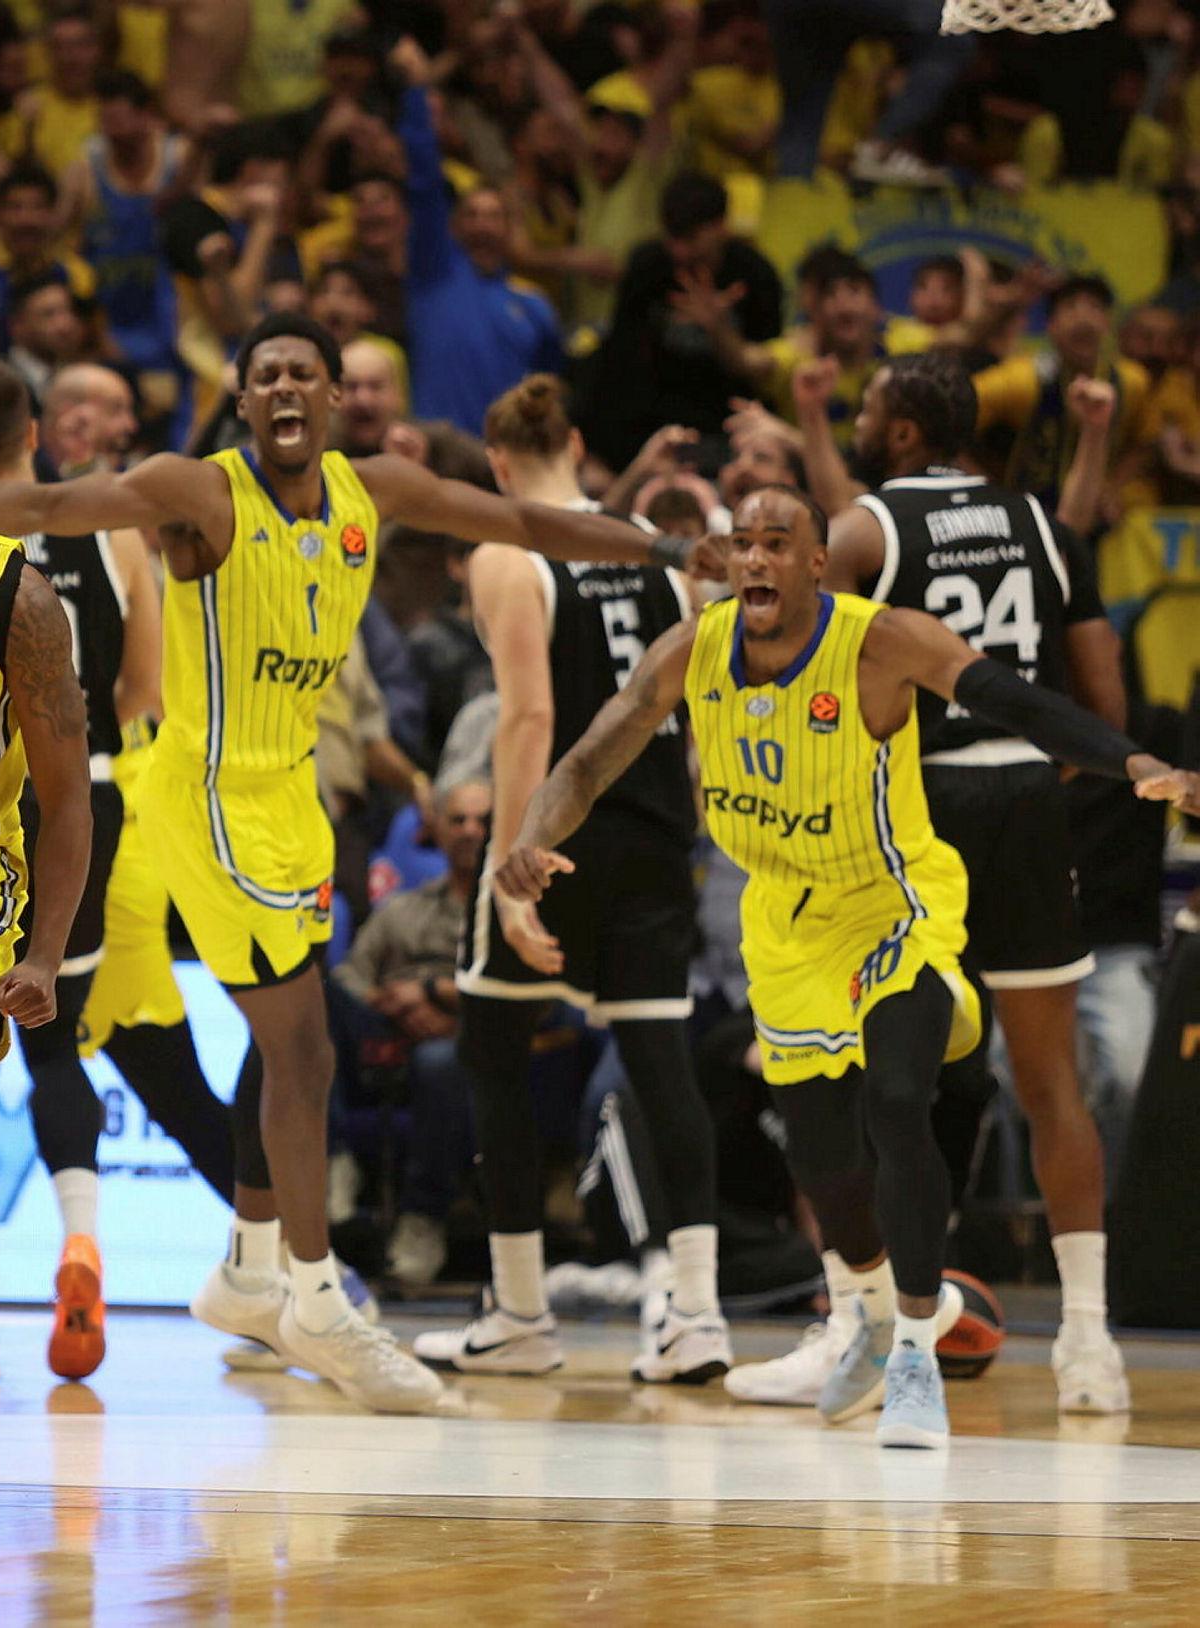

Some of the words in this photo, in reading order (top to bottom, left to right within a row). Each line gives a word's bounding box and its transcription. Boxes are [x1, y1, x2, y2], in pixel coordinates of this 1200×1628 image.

[306, 583, 319, 635] 1
[924, 565, 1042, 662] 24
[253, 648, 347, 691] Rapy
[601, 599, 647, 691] 5
[737, 737, 783, 784] 10
[703, 787, 832, 838] Rapyd
